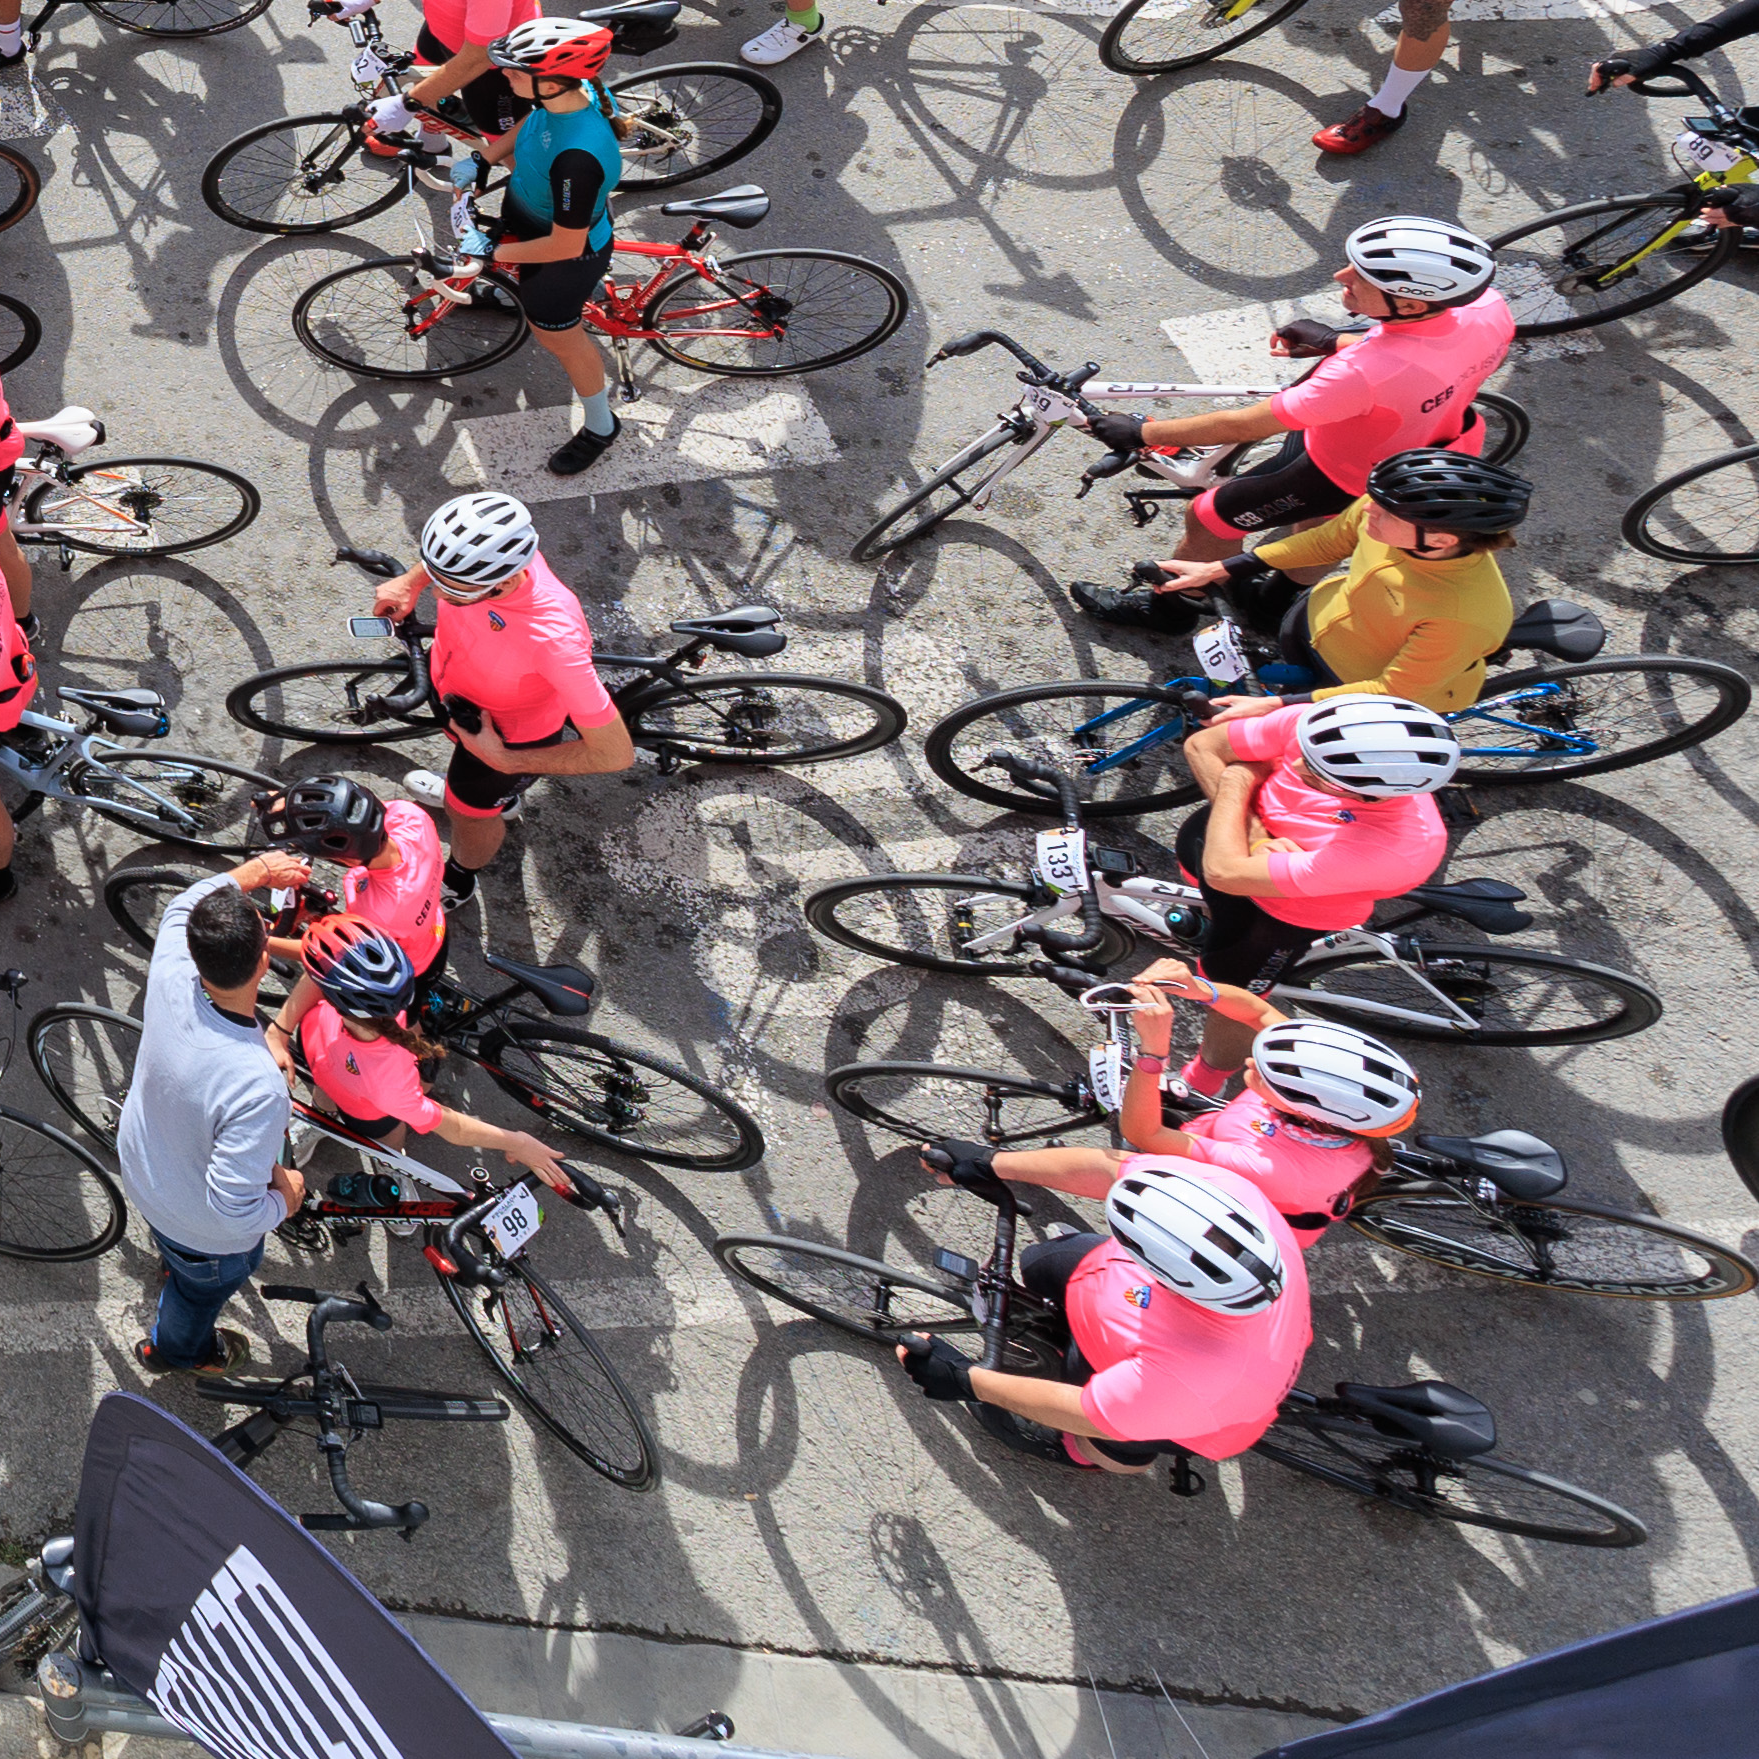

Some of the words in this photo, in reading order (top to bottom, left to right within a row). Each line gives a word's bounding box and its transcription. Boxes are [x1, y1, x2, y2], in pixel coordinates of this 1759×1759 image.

[1032, 394, 1051, 412] 39
[1421, 387, 1454, 415] CEB
[1234, 509, 1258, 529] CEB
[1204, 639, 1223, 669] 16
[1045, 838, 1072, 881] 133
[414, 899, 433, 927] CEB
[501, 1207, 530, 1240] 98
